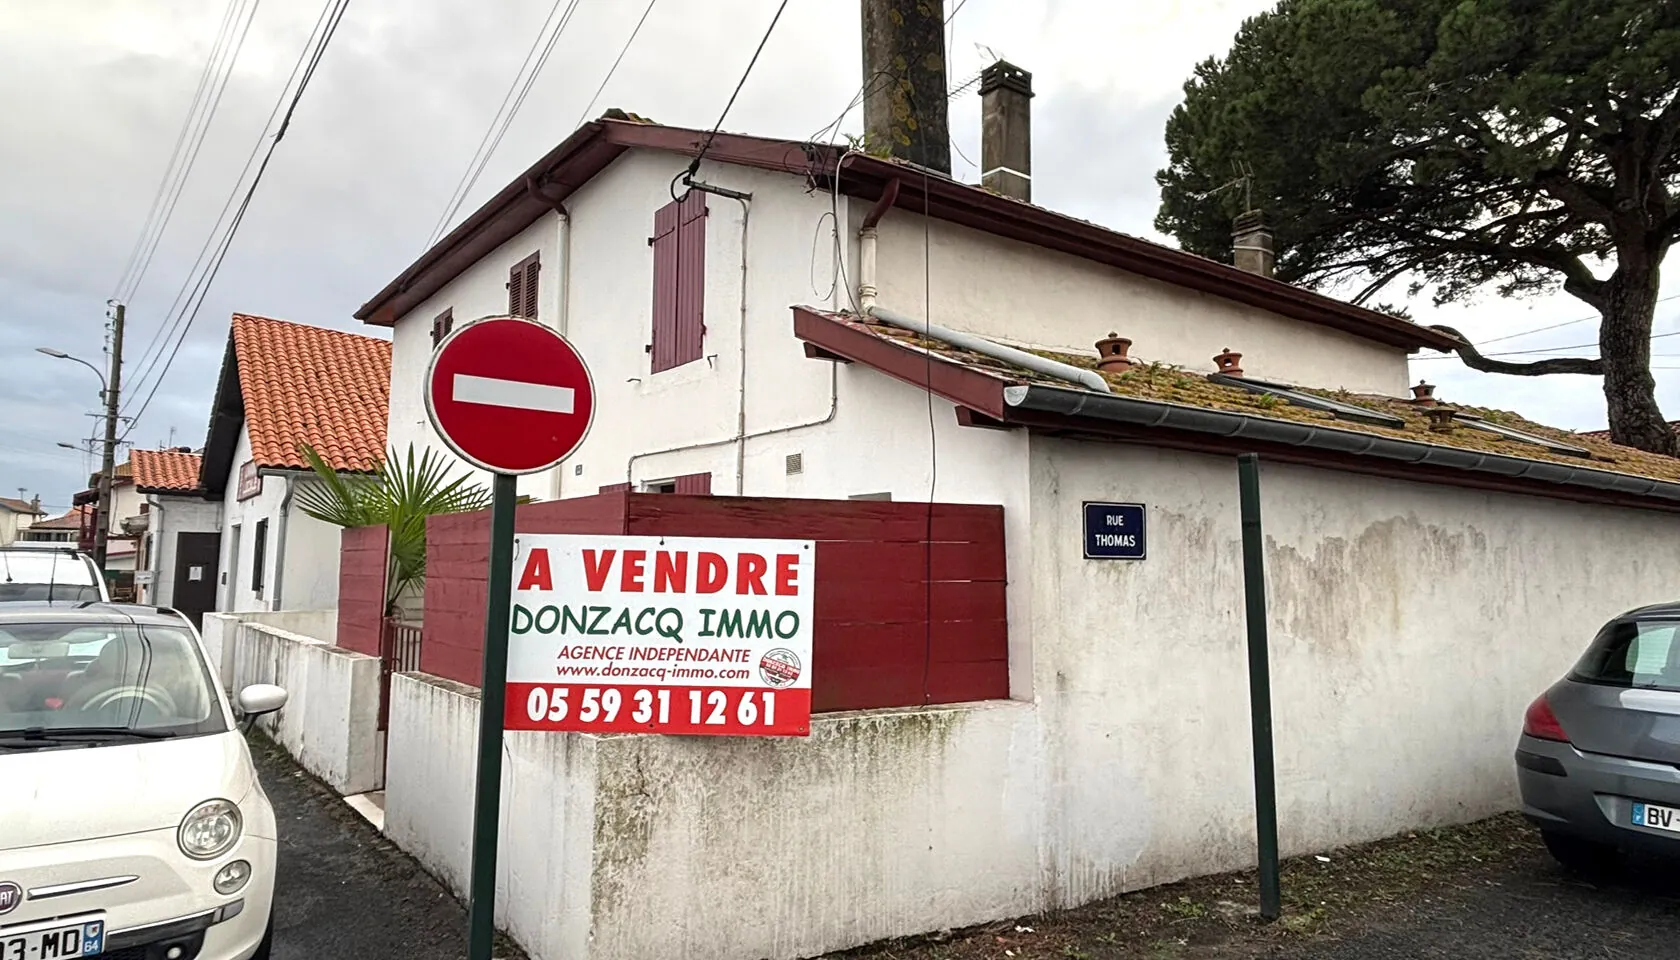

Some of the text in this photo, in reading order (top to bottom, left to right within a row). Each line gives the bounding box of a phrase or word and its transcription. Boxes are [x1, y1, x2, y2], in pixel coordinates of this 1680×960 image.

[1106, 514, 1124, 526] RUE
[1095, 534, 1136, 547] THOMAS
[518, 548, 800, 596] A VENDRE
[511, 604, 800, 643] DONZACQ IMMO
[557, 645, 625, 660] AGENCE
[628, 646, 751, 662] INDEPENDANTE
[556, 661, 750, 682] www.donzacq-immo.com
[527, 687, 776, 726] 05 59 31 12 61
[84, 940, 99, 953] 64
